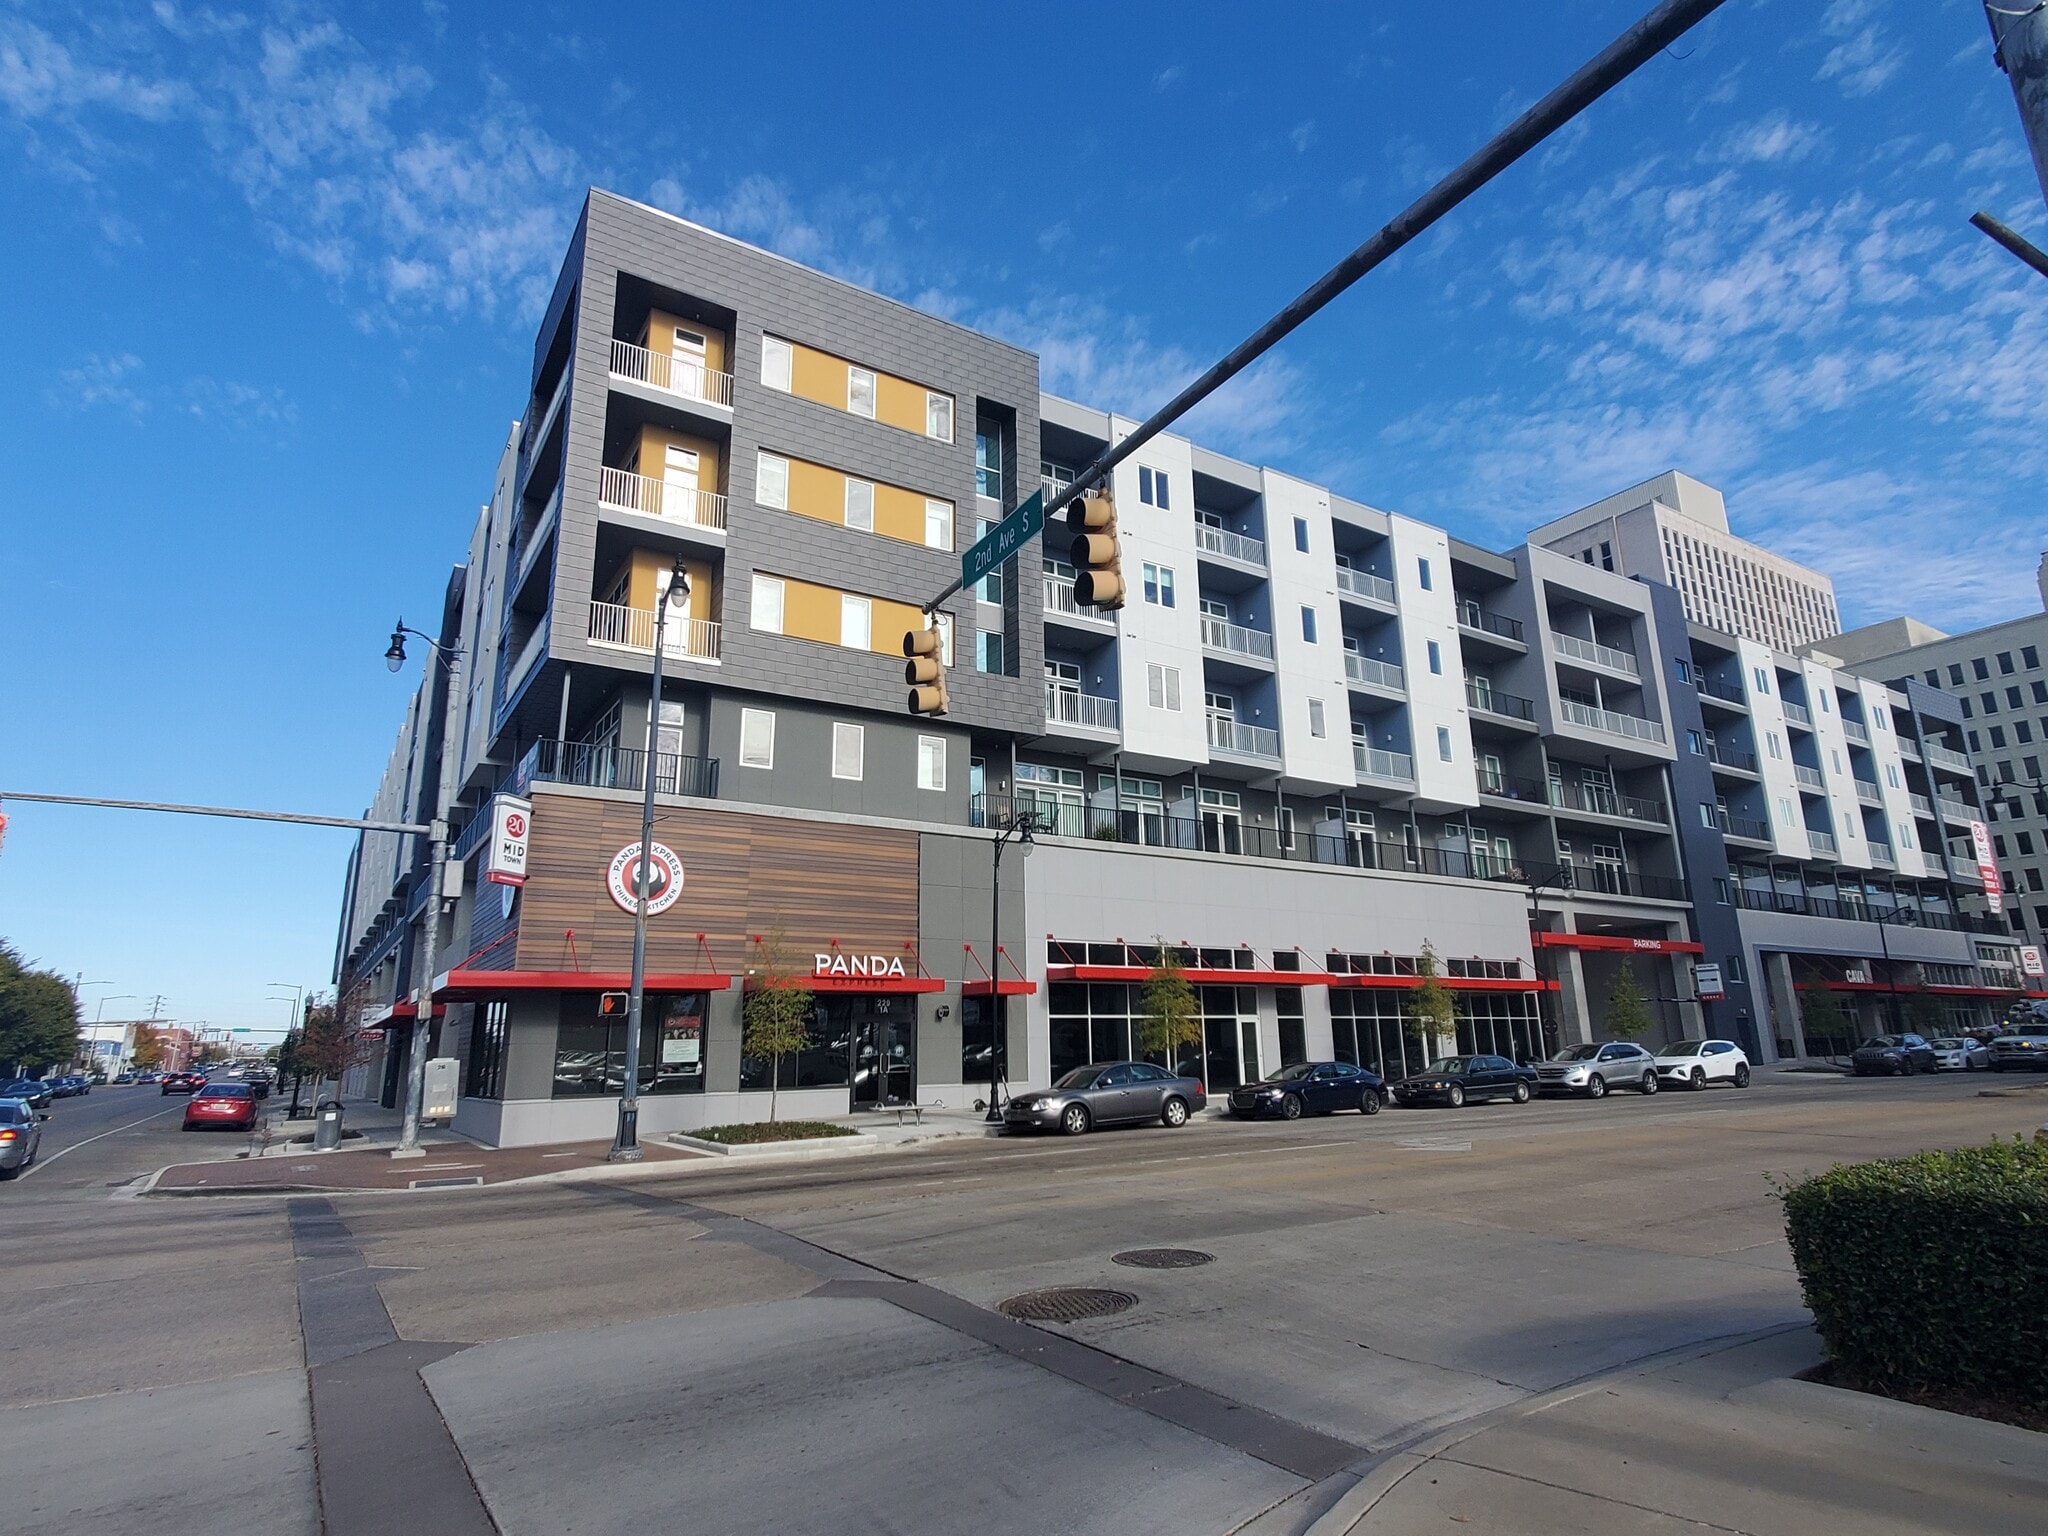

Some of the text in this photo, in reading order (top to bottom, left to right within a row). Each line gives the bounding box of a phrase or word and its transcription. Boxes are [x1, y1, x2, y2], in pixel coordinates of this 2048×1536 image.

[975, 511, 1029, 572] 2nd Ave S
[508, 816, 525, 834] 20
[503, 843, 525, 857] MID
[503, 855, 522, 865] TOWN
[613, 845, 681, 876] PANDA XPRESS
[614, 884, 638, 909] CHINES
[1633, 939, 1661, 949] PARKING
[814, 953, 906, 977] PANDA
[880, 1006, 889, 1014] 1A
